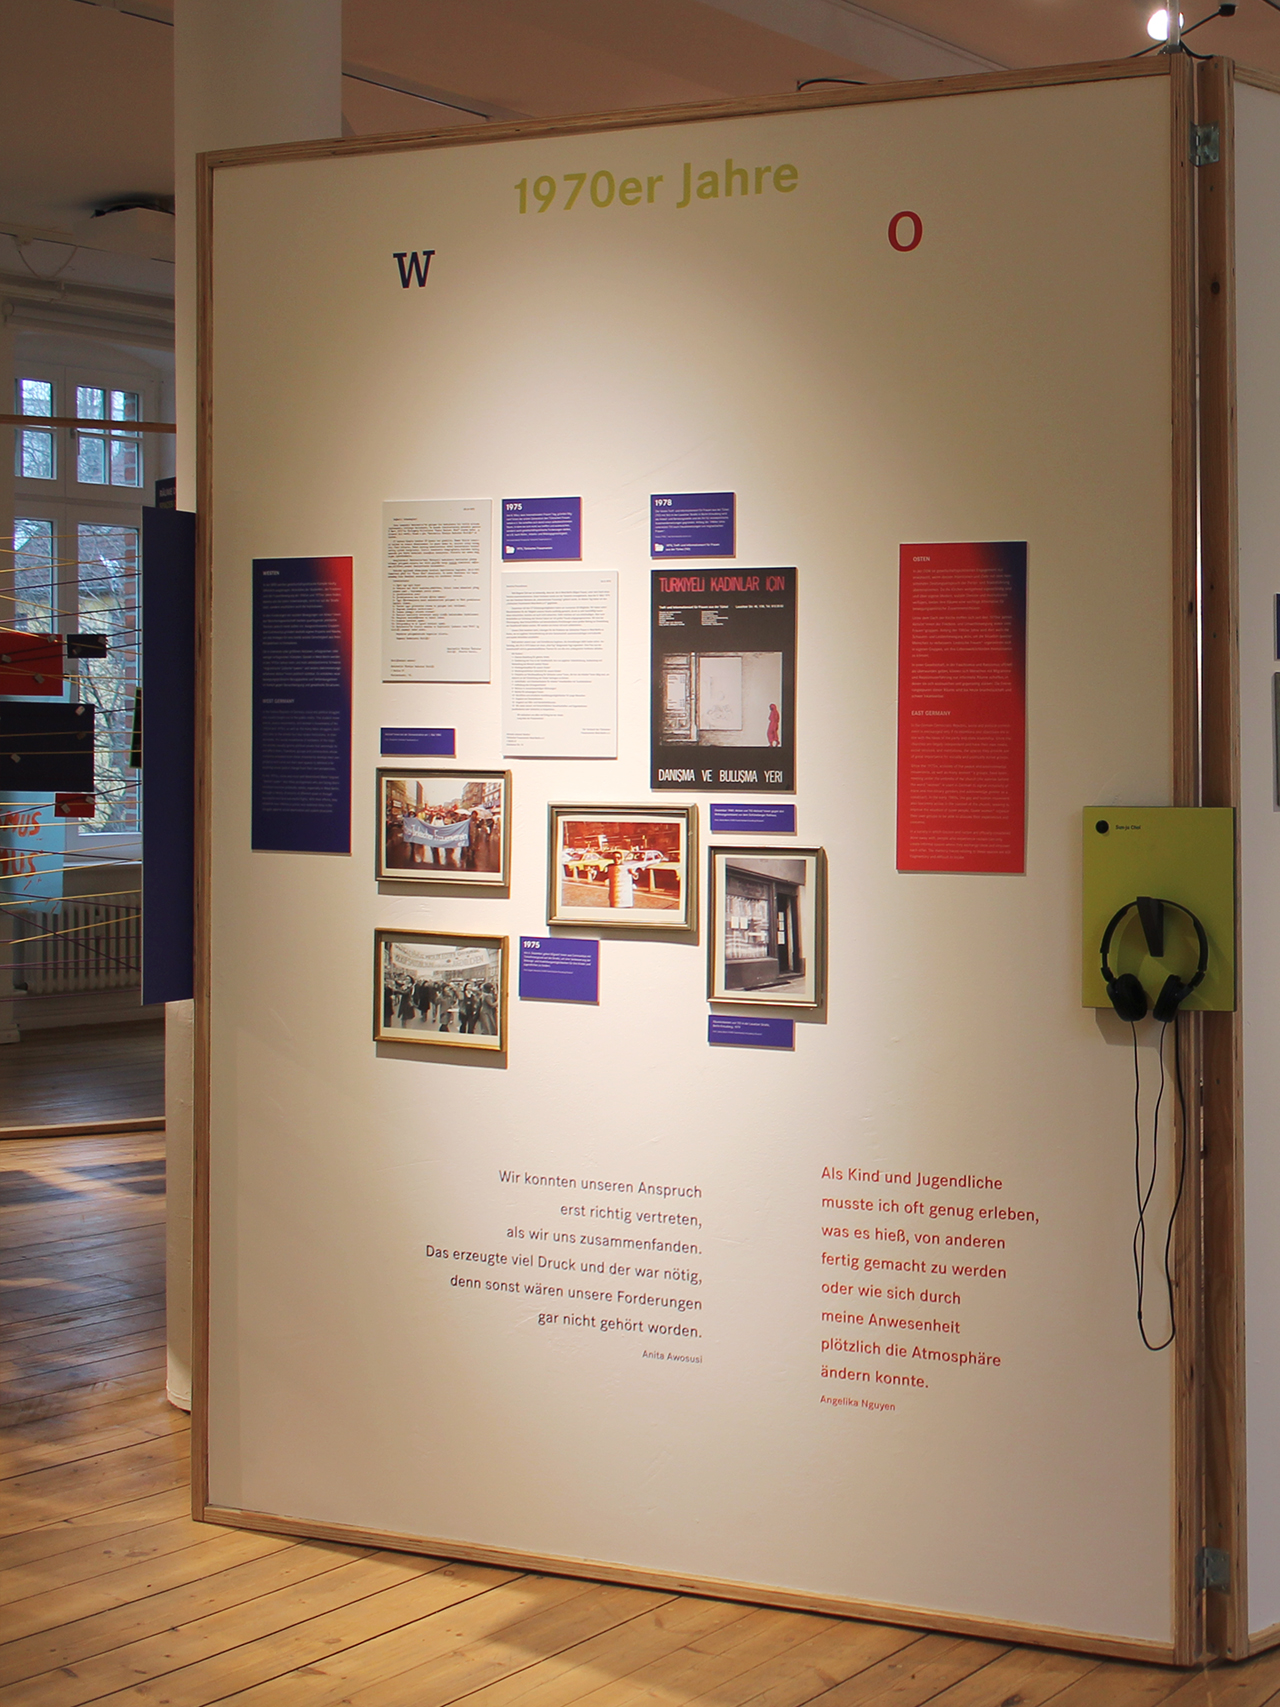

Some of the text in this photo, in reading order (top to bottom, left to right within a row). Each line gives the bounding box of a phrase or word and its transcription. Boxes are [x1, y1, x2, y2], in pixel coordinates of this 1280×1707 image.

[514, 159, 798, 214] 1970er Jahre
[888, 211, 922, 252] O
[393, 250, 435, 288] W
[710, 576, 760, 592] KADINLAR
[523, 941, 541, 949] 1975
[499, 1170, 701, 1198] Wir konnten unseren Anspruch
[822, 1167, 1002, 1189] Als Kind und Jugendliche
[561, 1206, 701, 1229] erst richtig vertreten,
[822, 1198, 1038, 1224] musste ich oft genug erleben,
[507, 1226, 701, 1254] als wir uns zusammenfanden.
[822, 1227, 1005, 1249] was es hieß, von anderen
[426, 1245, 702, 1285] Das erzeugte viel Druck und der war nötig,
[822, 1252, 1006, 1278] fertig gemacht zu werden
[451, 1275, 702, 1312] denn sonst wären unsere Forderungen
[822, 1282, 960, 1304] oder wie sich durch
[538, 1313, 701, 1337] gar nicht gehört worden.
[822, 1311, 960, 1333] meine Anwesenheit
[642, 1350, 702, 1363] Anita Awosusi
[822, 1338, 1000, 1366] plötzlich die Atmosphäre
[821, 1365, 928, 1388] ändern konnte.
[820, 1395, 895, 1411] Angelika Nguyen
